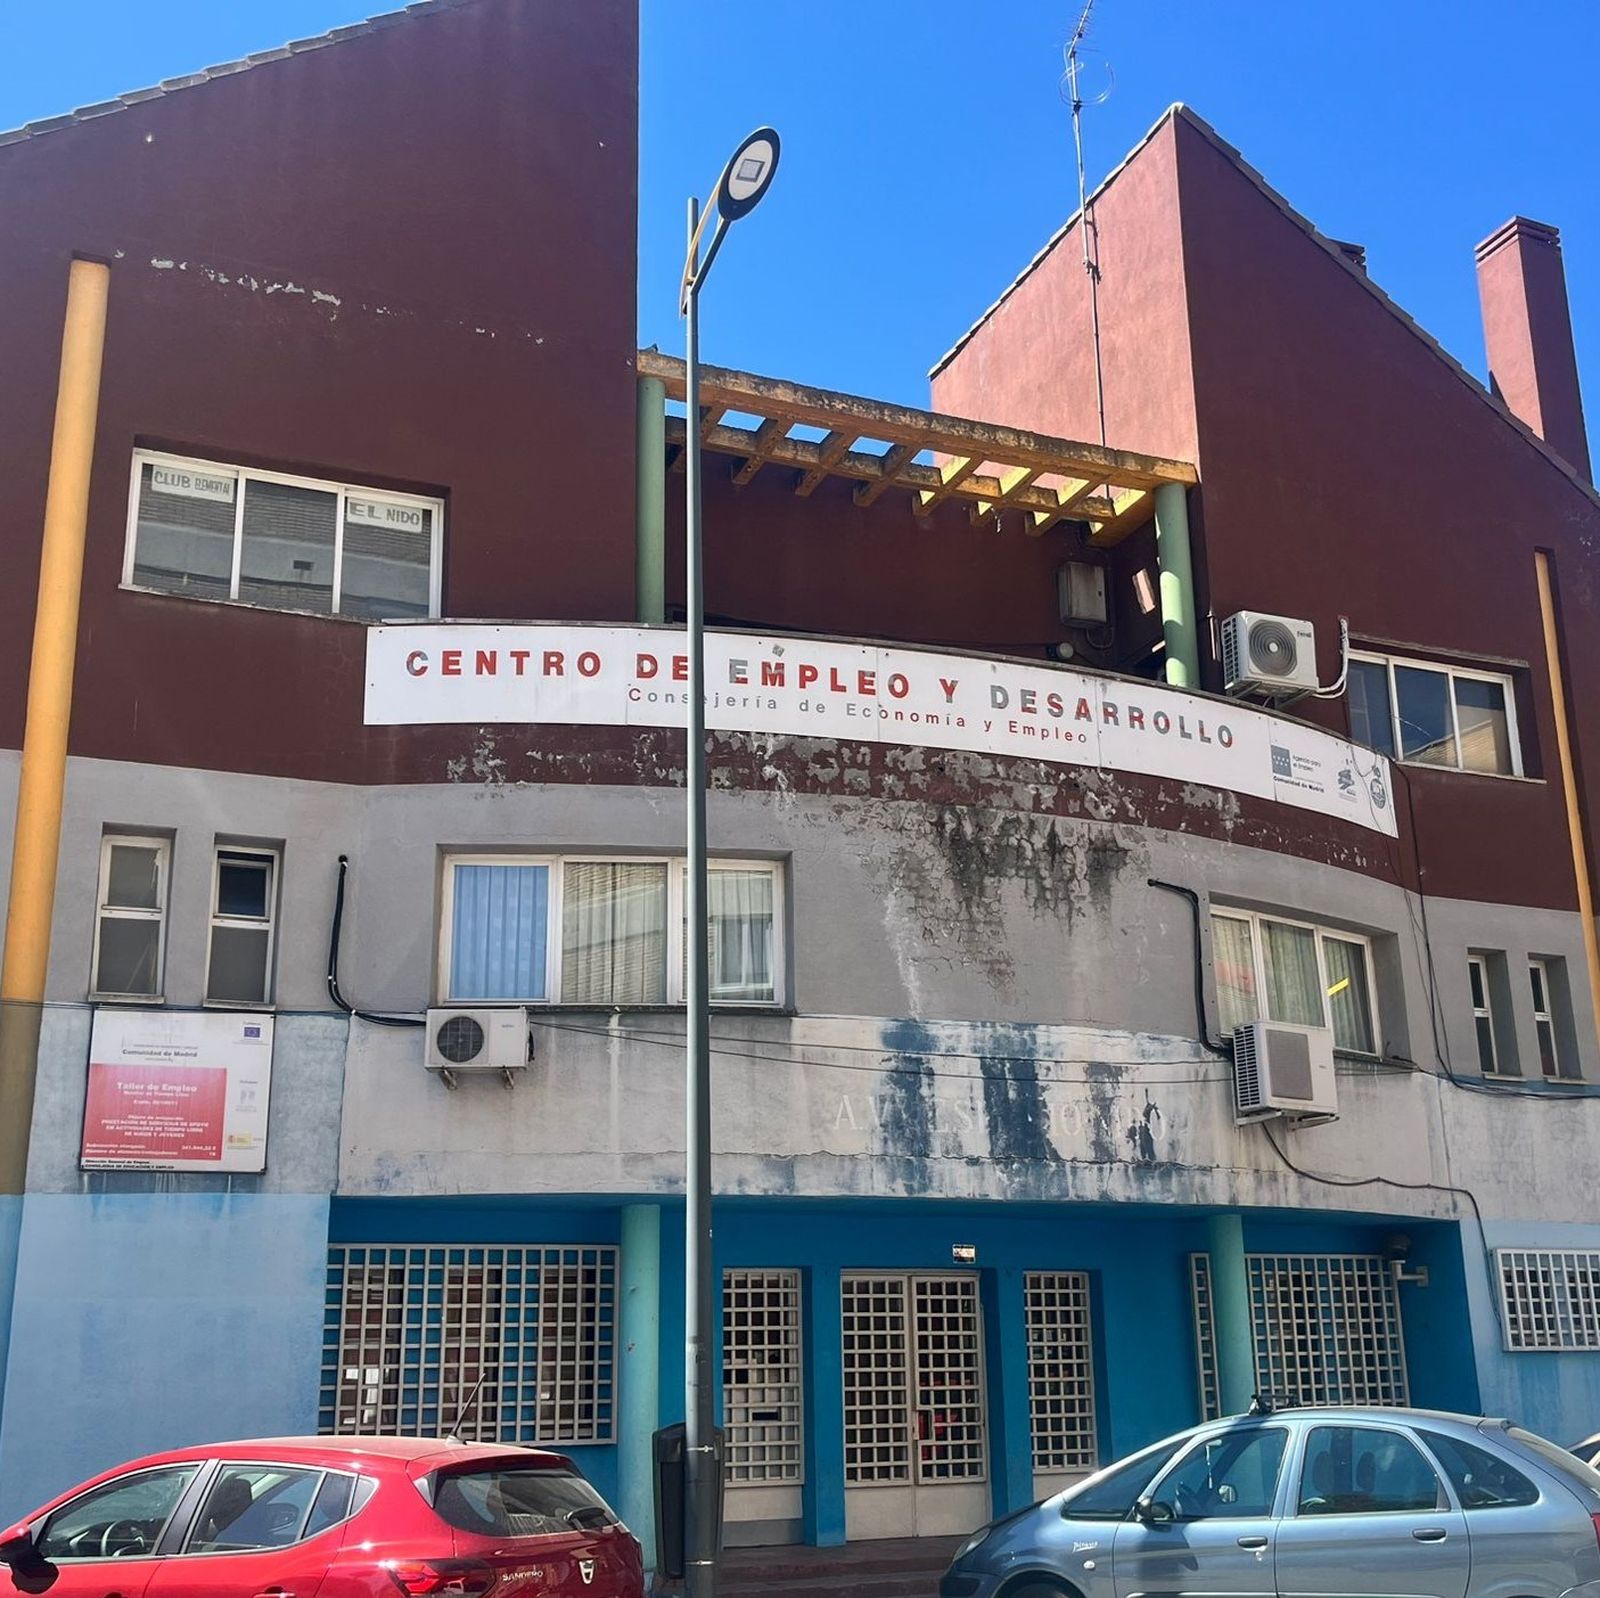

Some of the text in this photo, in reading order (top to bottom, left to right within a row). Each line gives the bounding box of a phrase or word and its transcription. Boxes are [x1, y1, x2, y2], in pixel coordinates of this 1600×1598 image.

[154, 471, 191, 488] CLUB
[349, 502, 420, 525] EL NIDO
[406, 650, 1233, 748] CENTRO DE EMPLEO Y DESARROLLO
[799, 699, 826, 714] de
[846, 702, 965, 728] Economía
[983, 718, 993, 732] y
[1008, 720, 1087, 743] Empleo
[117, 1082, 198, 1093] Taller de Empleo
[502, 1570, 544, 1581] SANDERO
